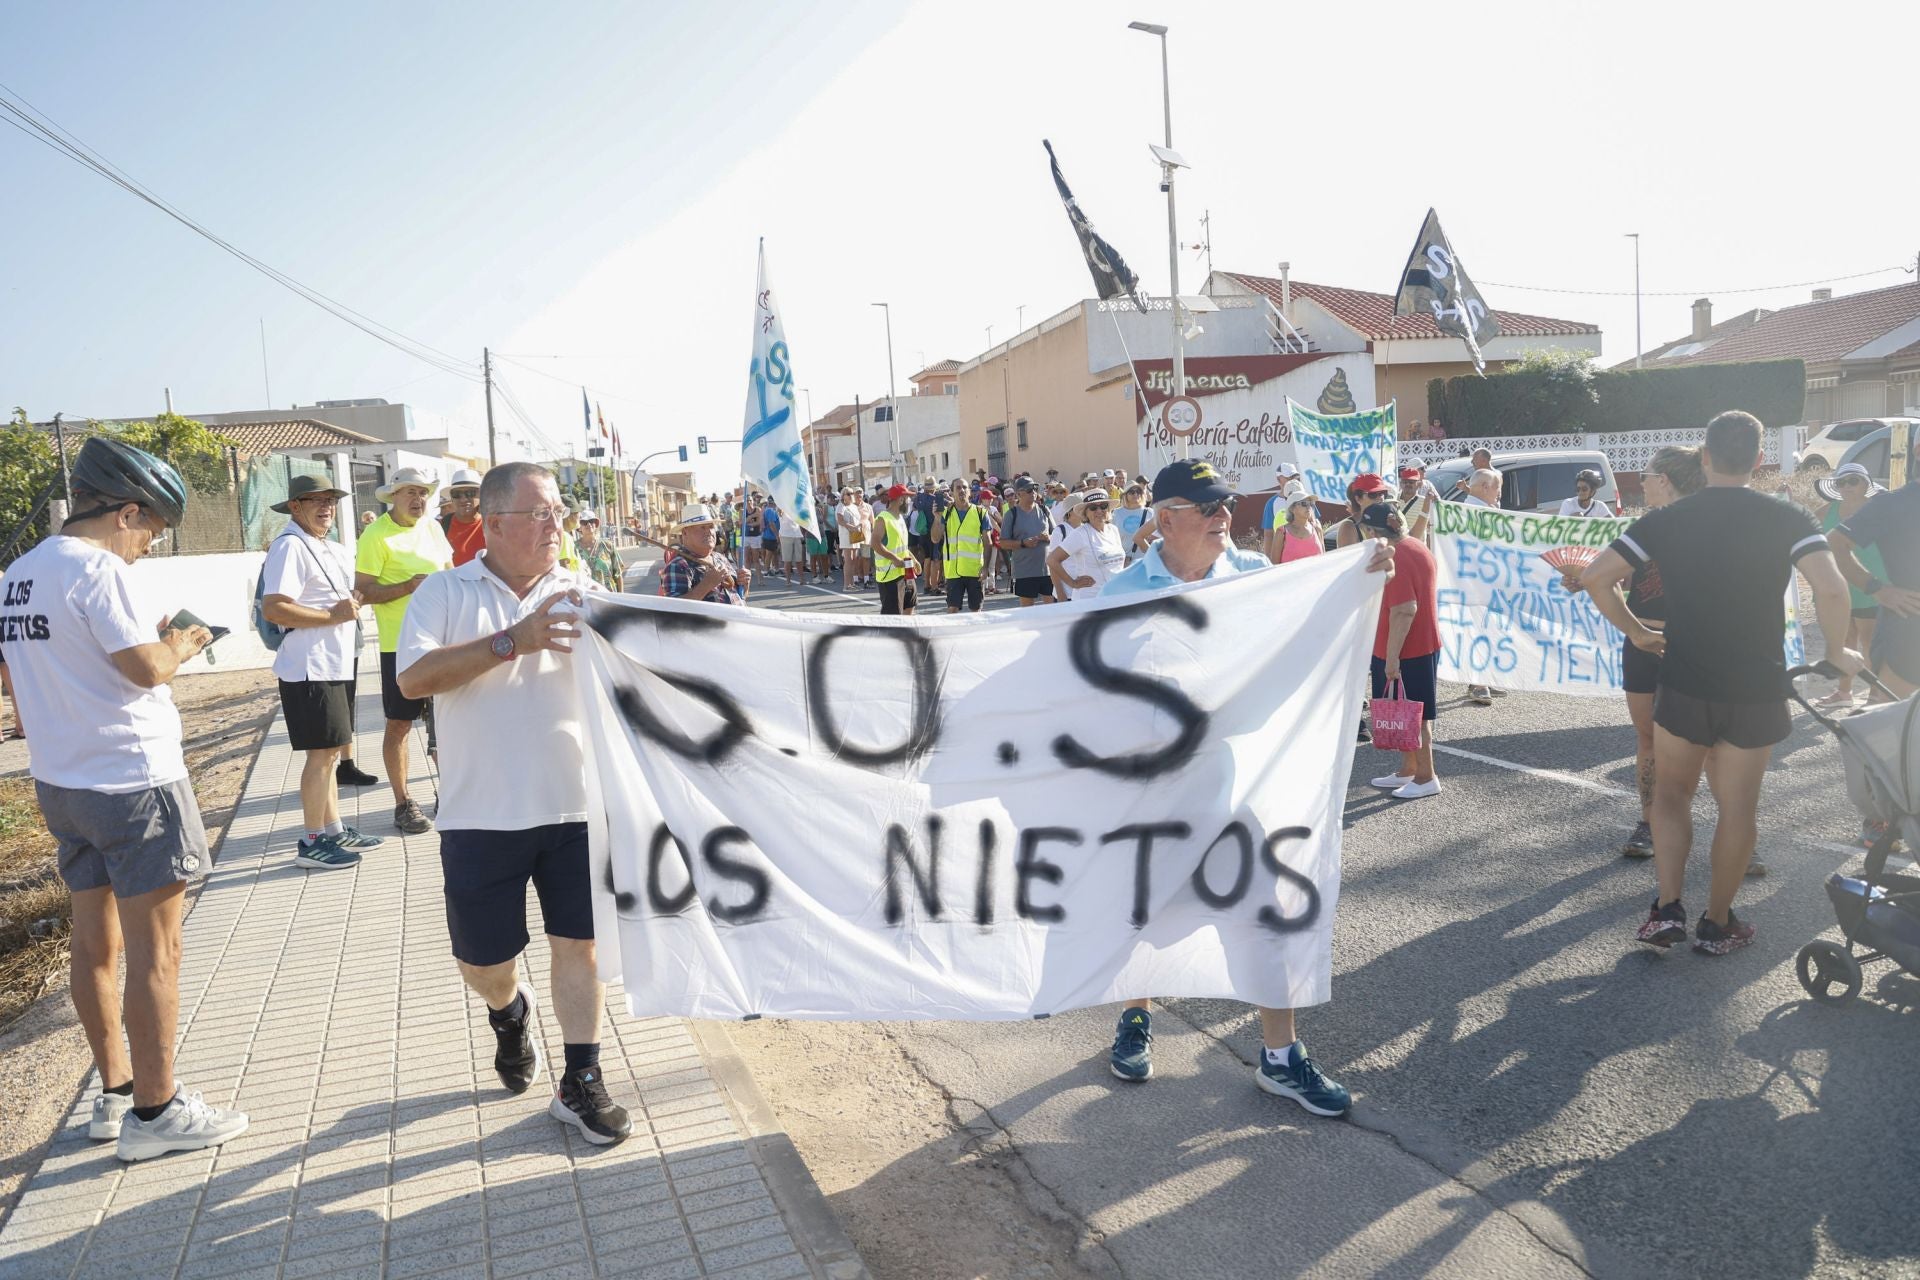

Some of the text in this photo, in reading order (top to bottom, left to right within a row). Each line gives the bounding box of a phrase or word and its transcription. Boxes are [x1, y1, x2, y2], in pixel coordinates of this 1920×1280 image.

[1146, 371, 1251, 395] Jijnenca
[1170, 407, 1195, 424] 30
[1233, 449, 1273, 468] Náutico
[1330, 449, 1377, 475] NO
[1304, 468, 1348, 501] PARA
[1435, 501, 1468, 536] LOS
[1467, 510, 1515, 543] NIETOS
[1456, 538, 1542, 590] ESTE
[3, 579, 34, 607] LOS
[0, 613, 51, 643] IETOS
[1437, 588, 1626, 648] EL AYUNTAM
[1438, 632, 1518, 673] NOS
[1375, 719, 1404, 731] DRUNI
[882, 813, 1322, 934] NIETOS
